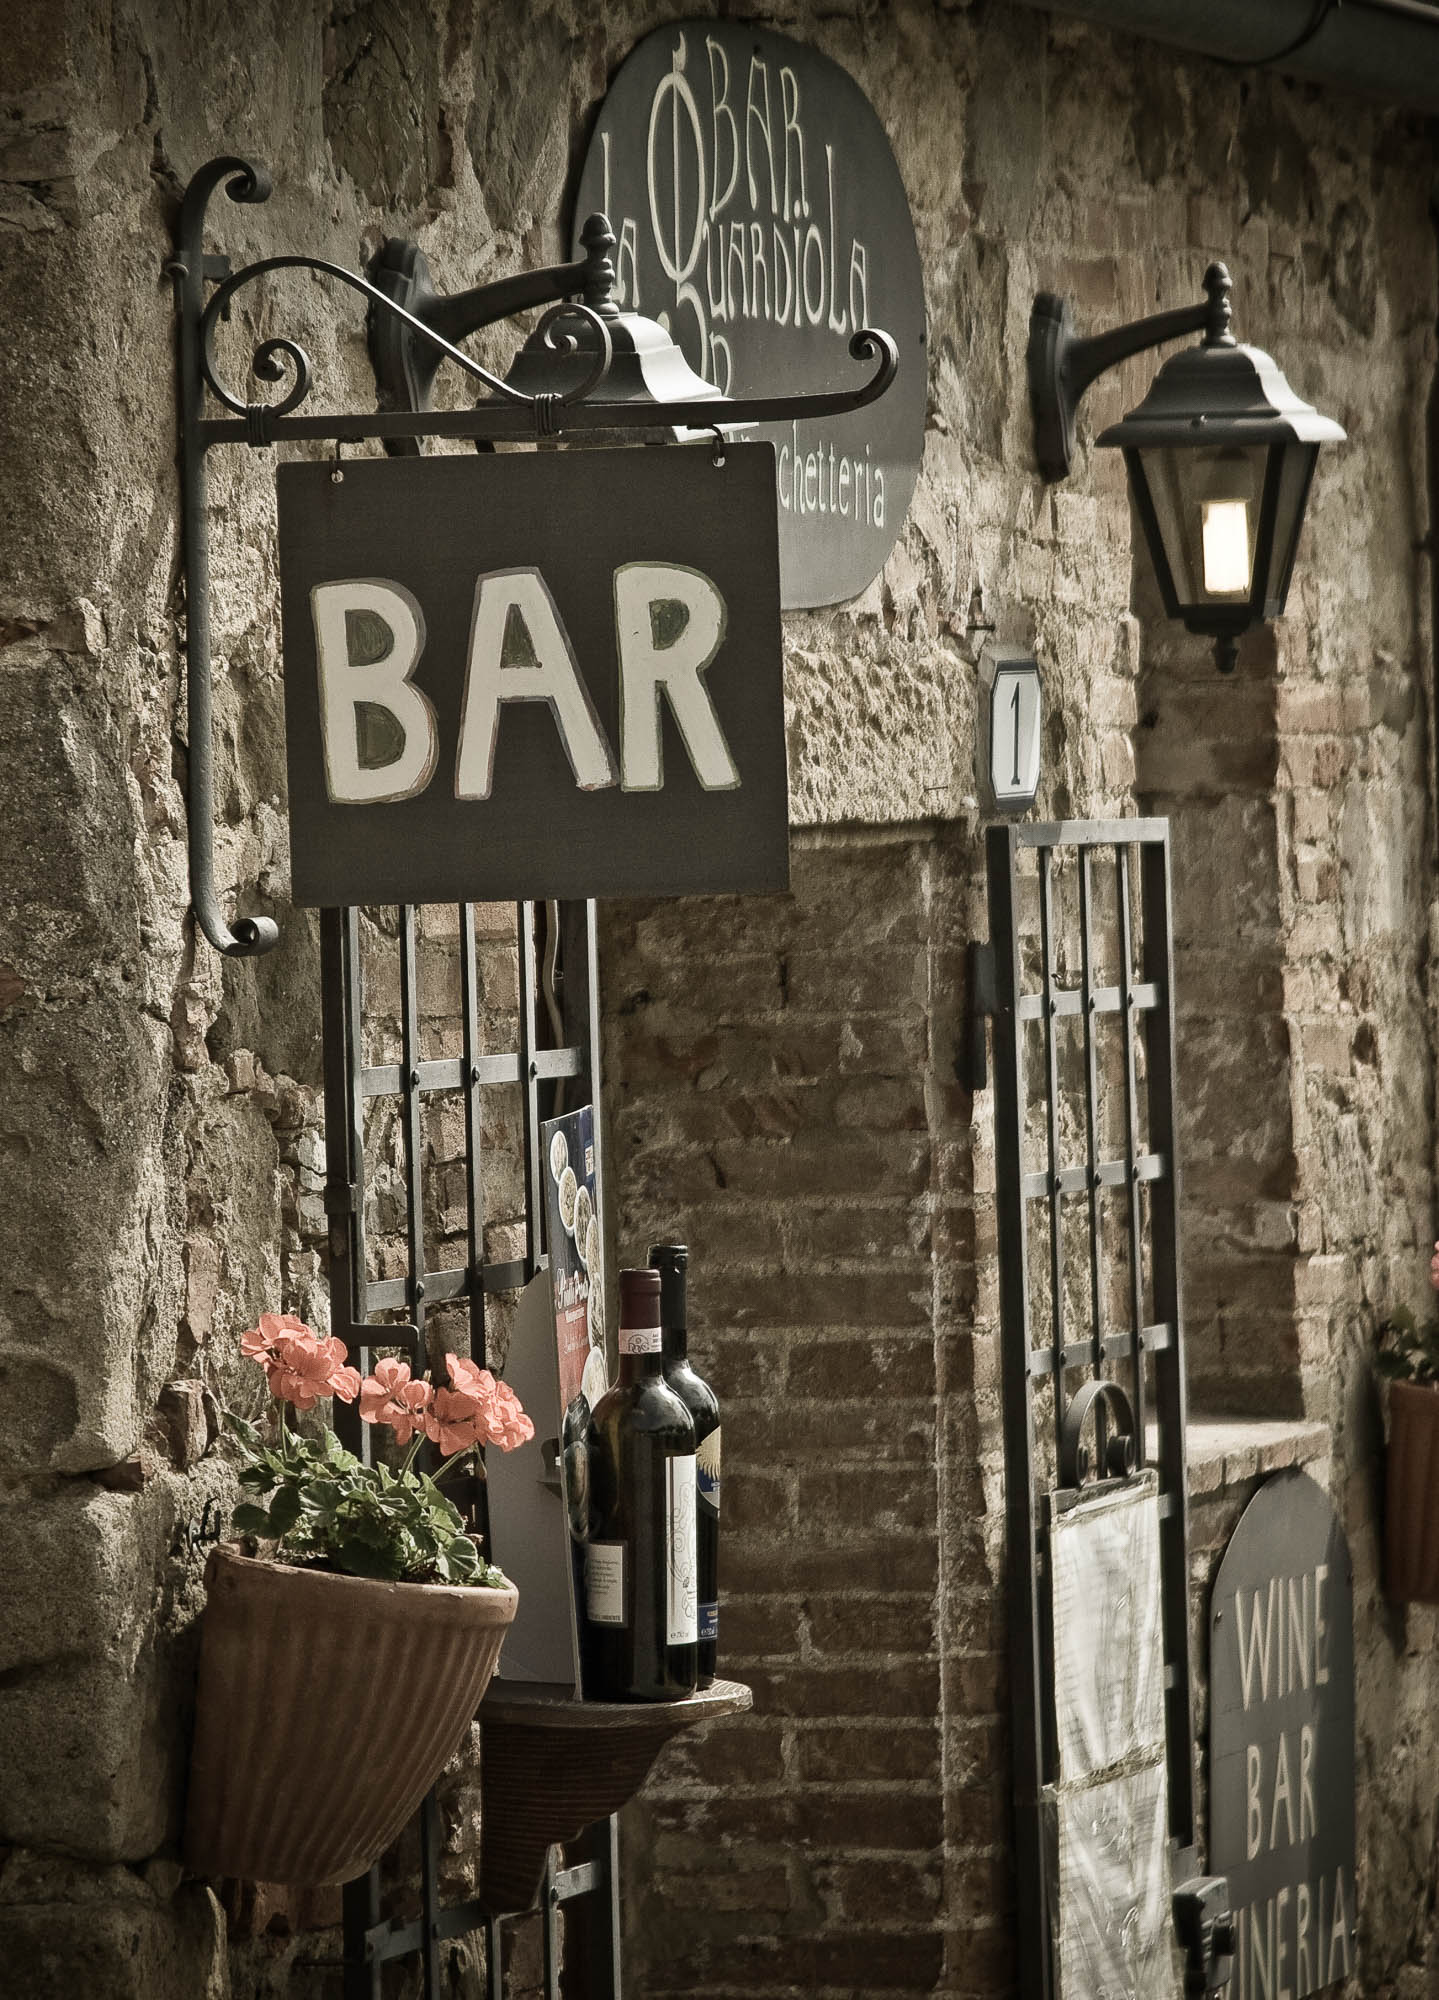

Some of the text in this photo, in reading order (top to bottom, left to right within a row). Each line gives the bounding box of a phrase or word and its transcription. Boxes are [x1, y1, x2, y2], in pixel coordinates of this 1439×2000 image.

[705, 34, 810, 223] BAR
[310, 561, 742, 805] BAR
[1010, 681, 1021, 786] 1
[1235, 1564, 1330, 1712] WINE
[1246, 1723, 1318, 1862] BAR
